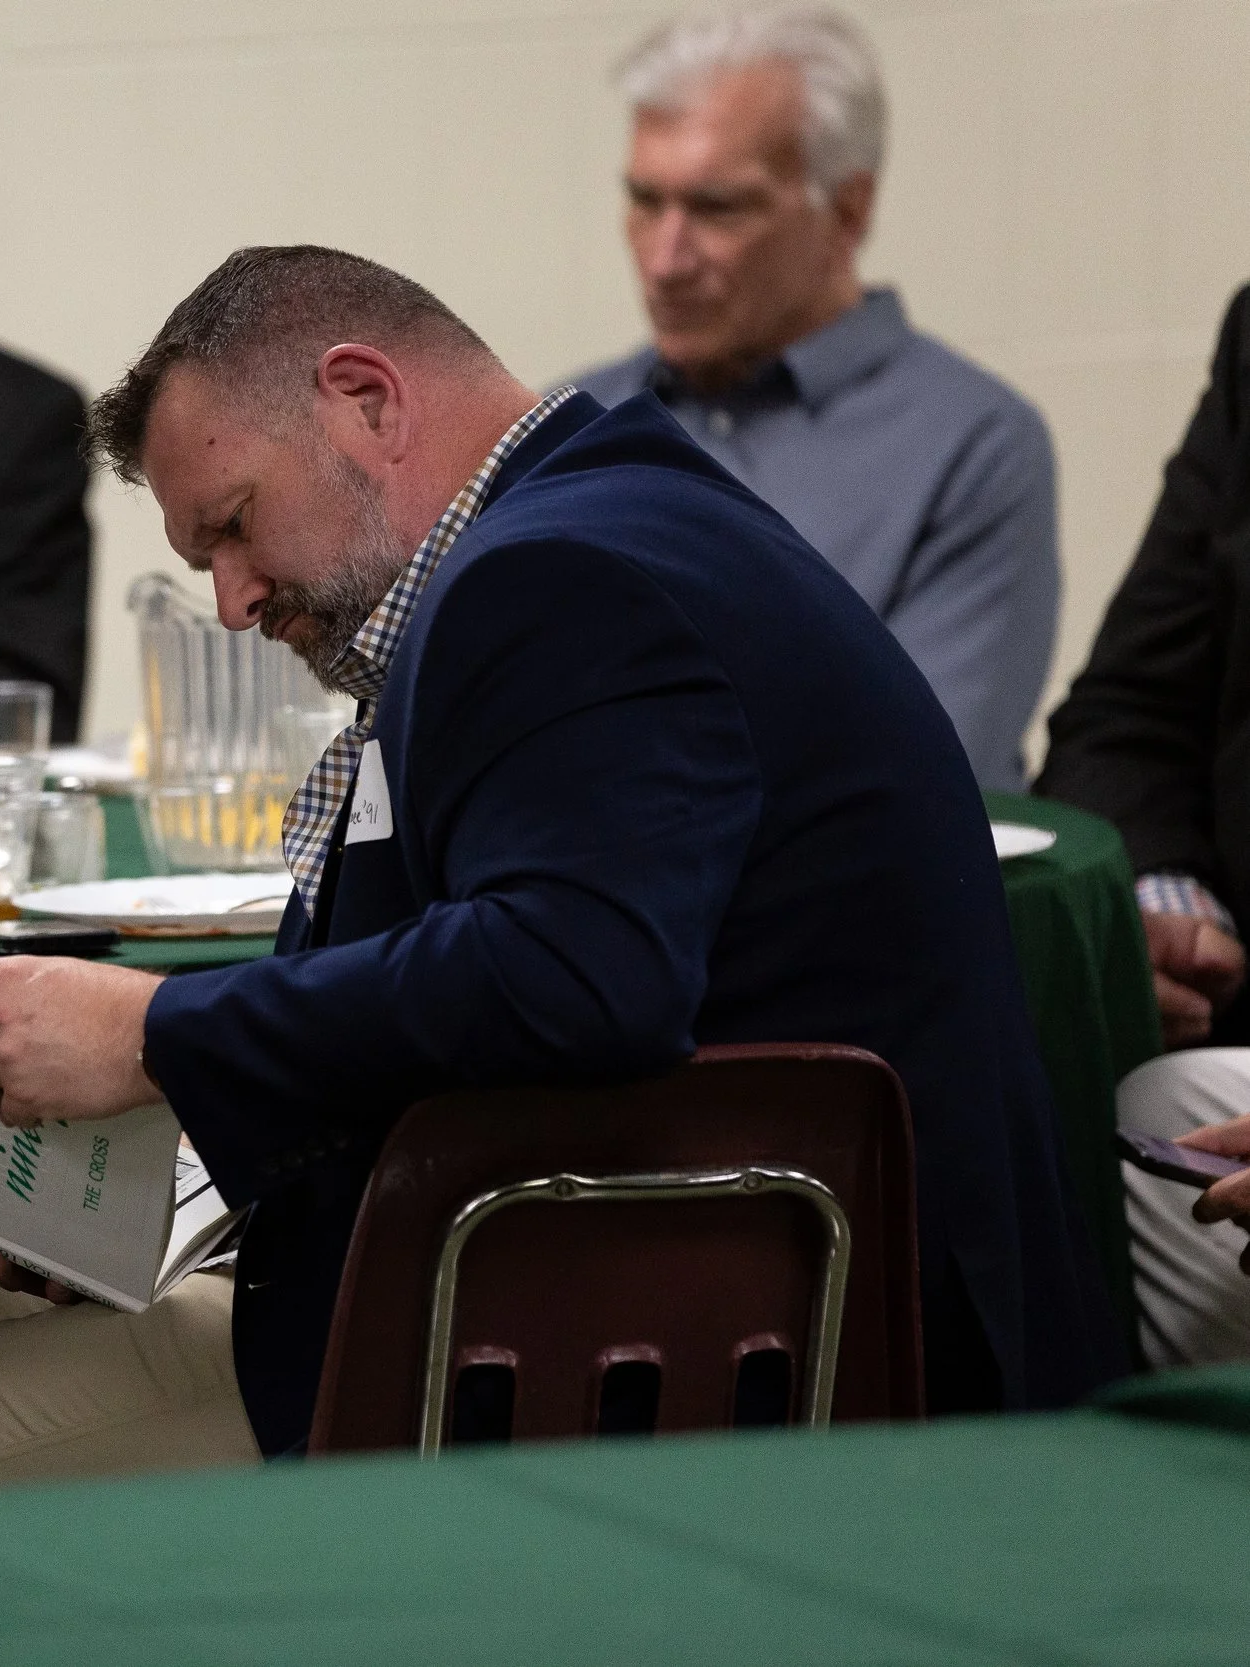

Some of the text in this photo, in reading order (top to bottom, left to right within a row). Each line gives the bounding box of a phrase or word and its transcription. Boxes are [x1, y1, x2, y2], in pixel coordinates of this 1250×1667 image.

[363, 799, 379, 825] '91
[83, 1135, 110, 1212] THE CROSS
